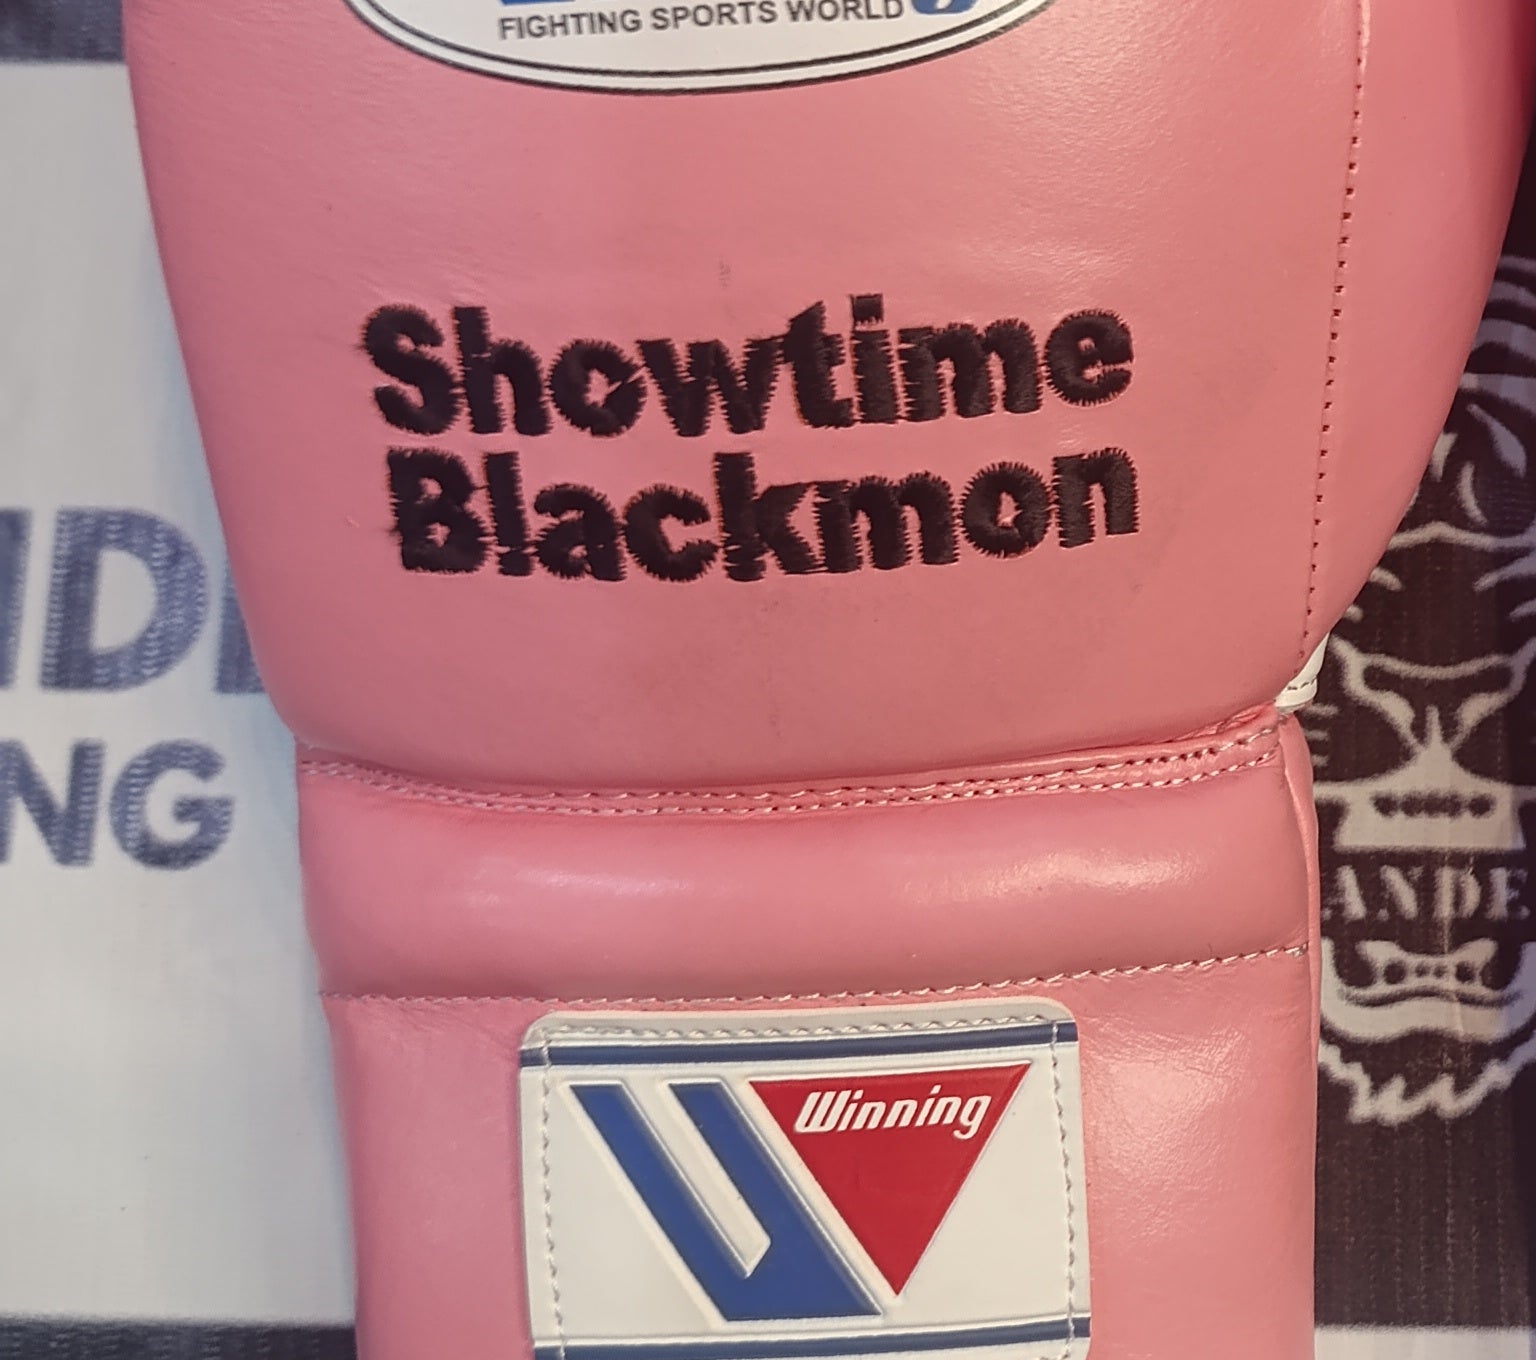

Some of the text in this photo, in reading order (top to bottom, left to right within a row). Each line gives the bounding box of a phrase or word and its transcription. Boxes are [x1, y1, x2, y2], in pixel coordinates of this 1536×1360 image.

[499, 8, 642, 40] FIGHTING
[650, 0, 779, 30] SPORTS
[360, 292, 1136, 438] Showtime
[386, 446, 1142, 583] Blackmon
[794, 1085, 992, 1140] Winning
